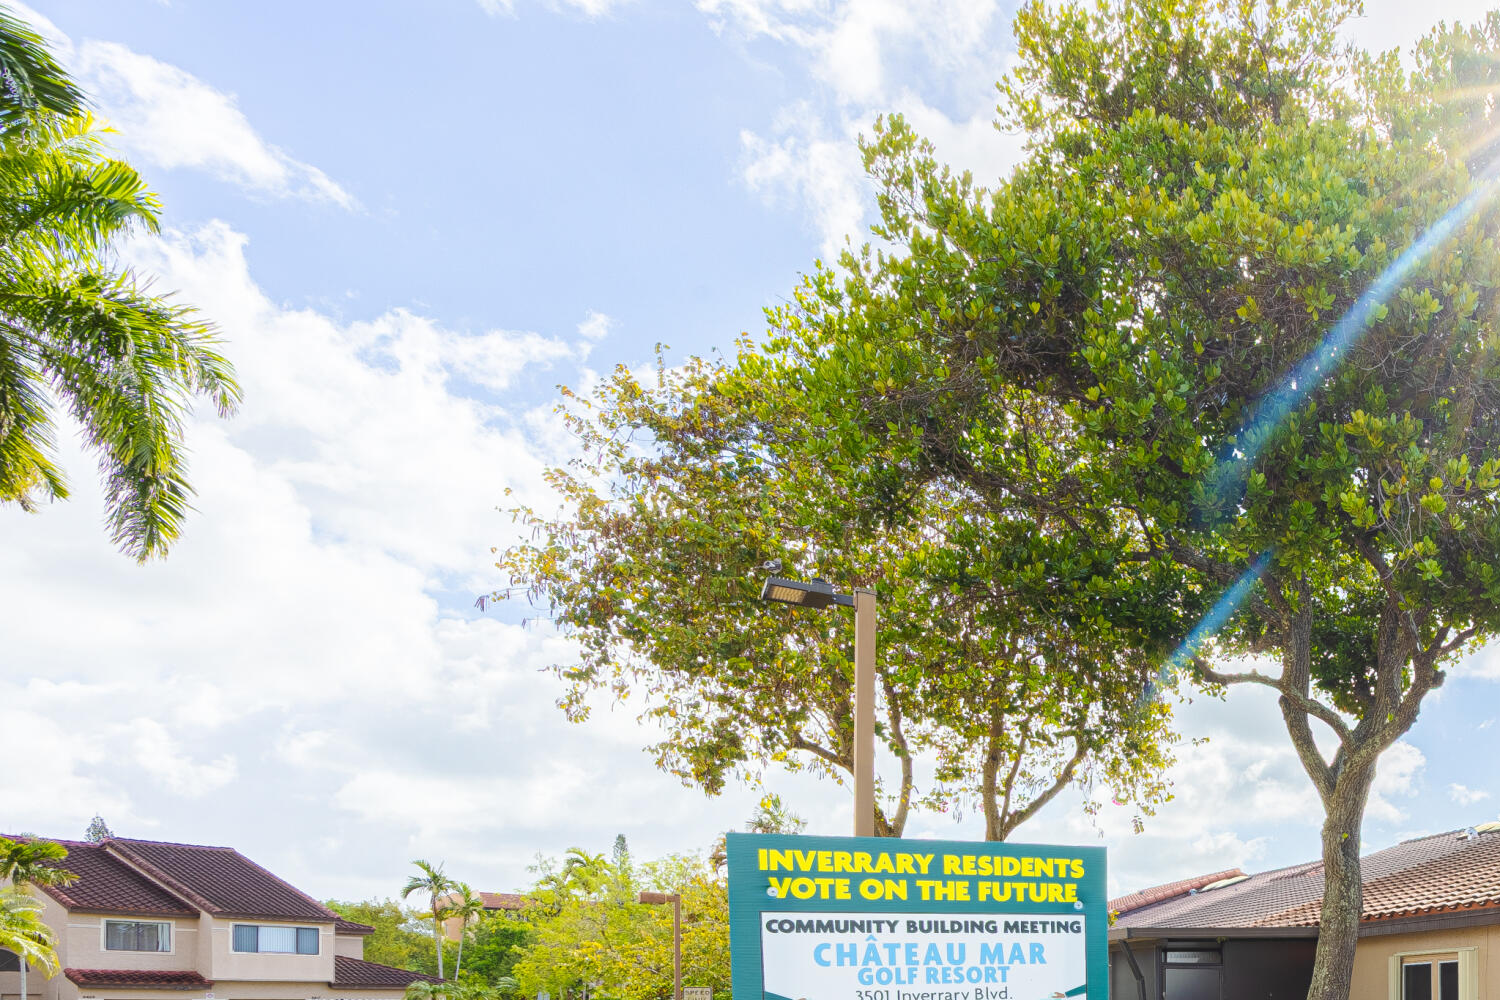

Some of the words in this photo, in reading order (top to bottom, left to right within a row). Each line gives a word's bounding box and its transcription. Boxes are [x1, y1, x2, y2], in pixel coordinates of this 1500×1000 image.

[758, 848, 935, 874] INVERRARY
[943, 854, 1085, 879] RESIDENTS
[768, 877, 852, 900] VOTE
[859, 878, 908, 901] ON
[916, 880, 970, 902] THE
[978, 881, 1078, 903] FUTURE
[765, 919, 900, 934] COMMUNITY
[906, 920, 998, 934] BUILDING
[1003, 920, 1082, 934] MEETING
[813, 935, 967, 967] CHÂTEAU
[979, 942, 1047, 965] MAR
[857, 967, 918, 986] GOLF
[925, 966, 1010, 984] RESORT
[975, 986, 1013, 1000] Blvd.
